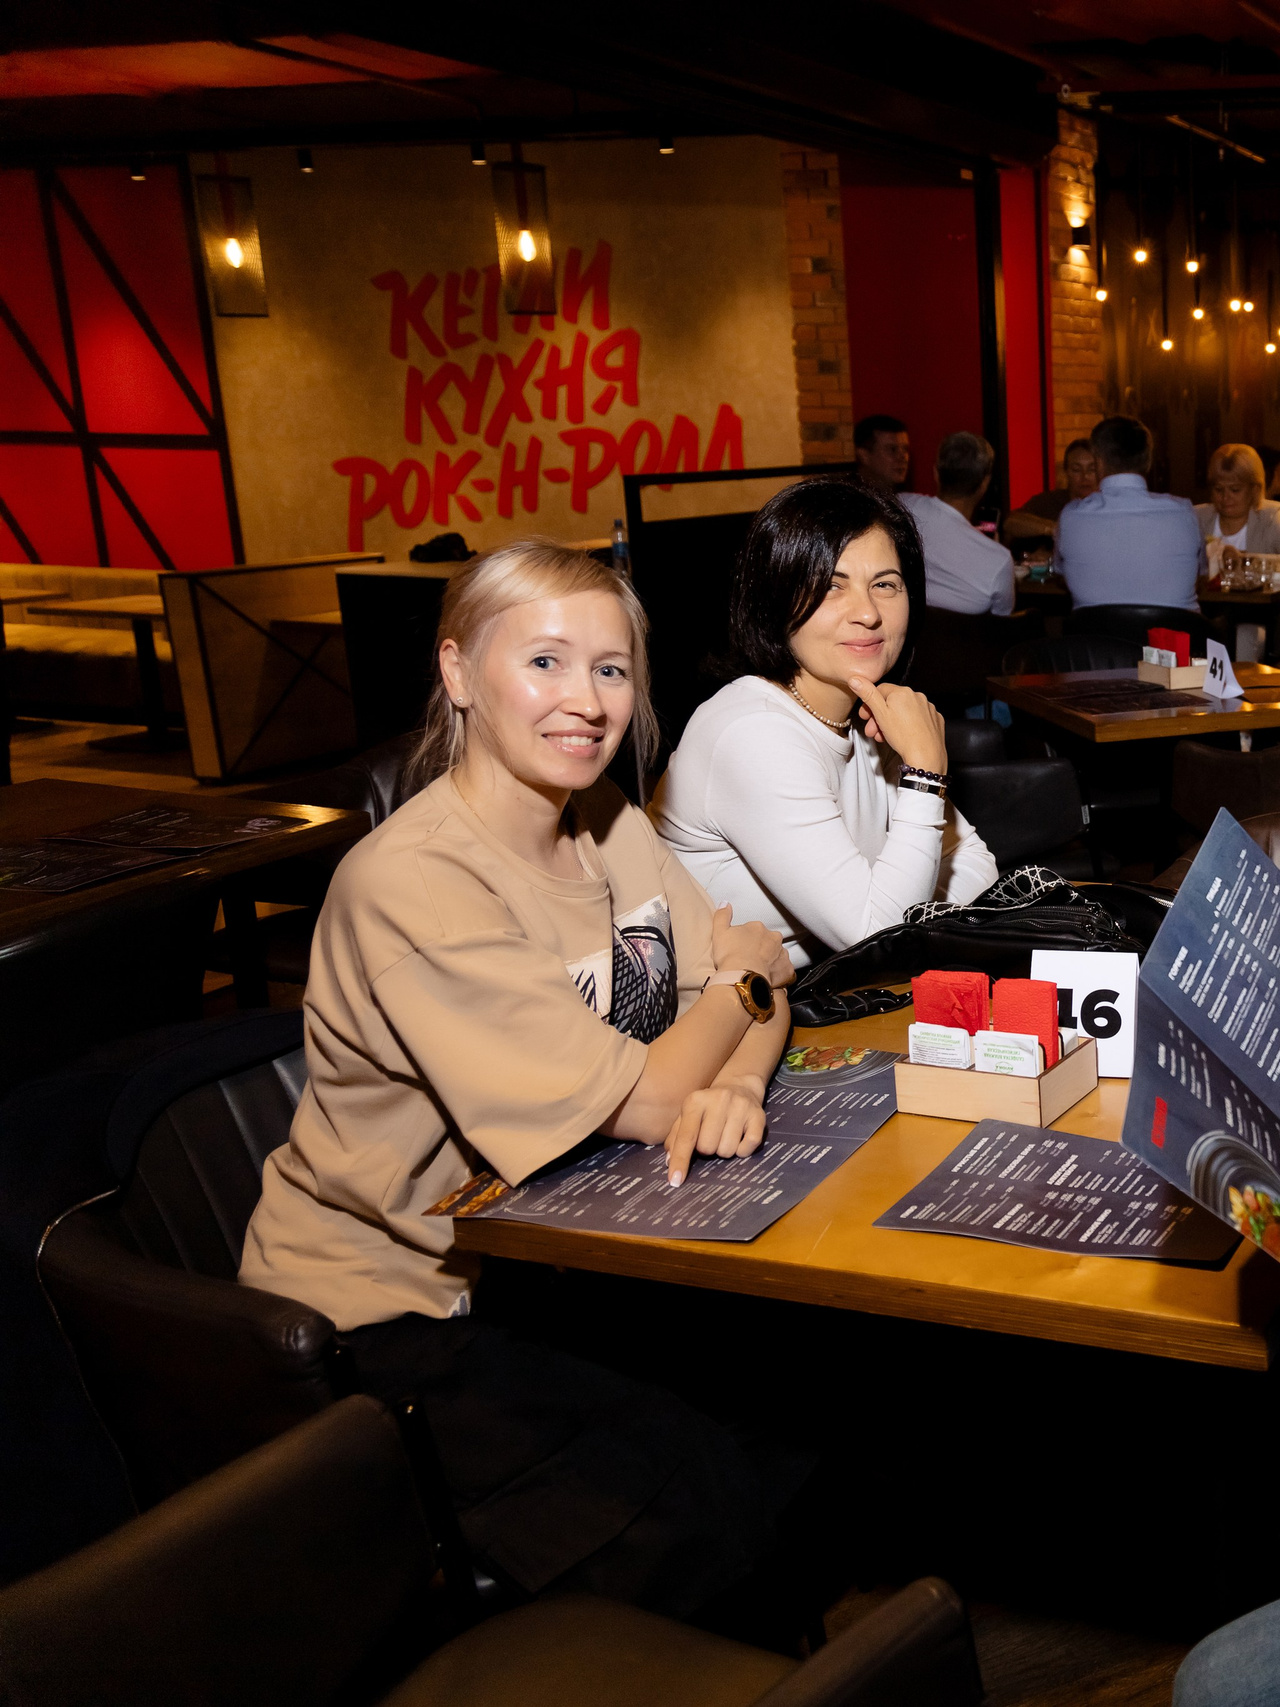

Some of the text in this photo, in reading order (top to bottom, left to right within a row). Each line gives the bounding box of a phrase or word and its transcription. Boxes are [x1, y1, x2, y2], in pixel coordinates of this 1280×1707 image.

[404, 327, 640, 446] КУХНЯ
[333, 403, 744, 552] РОК-Н-РОЛЛ
[1209, 656, 1224, 681] 41
[1057, 988, 1122, 1039] 16
